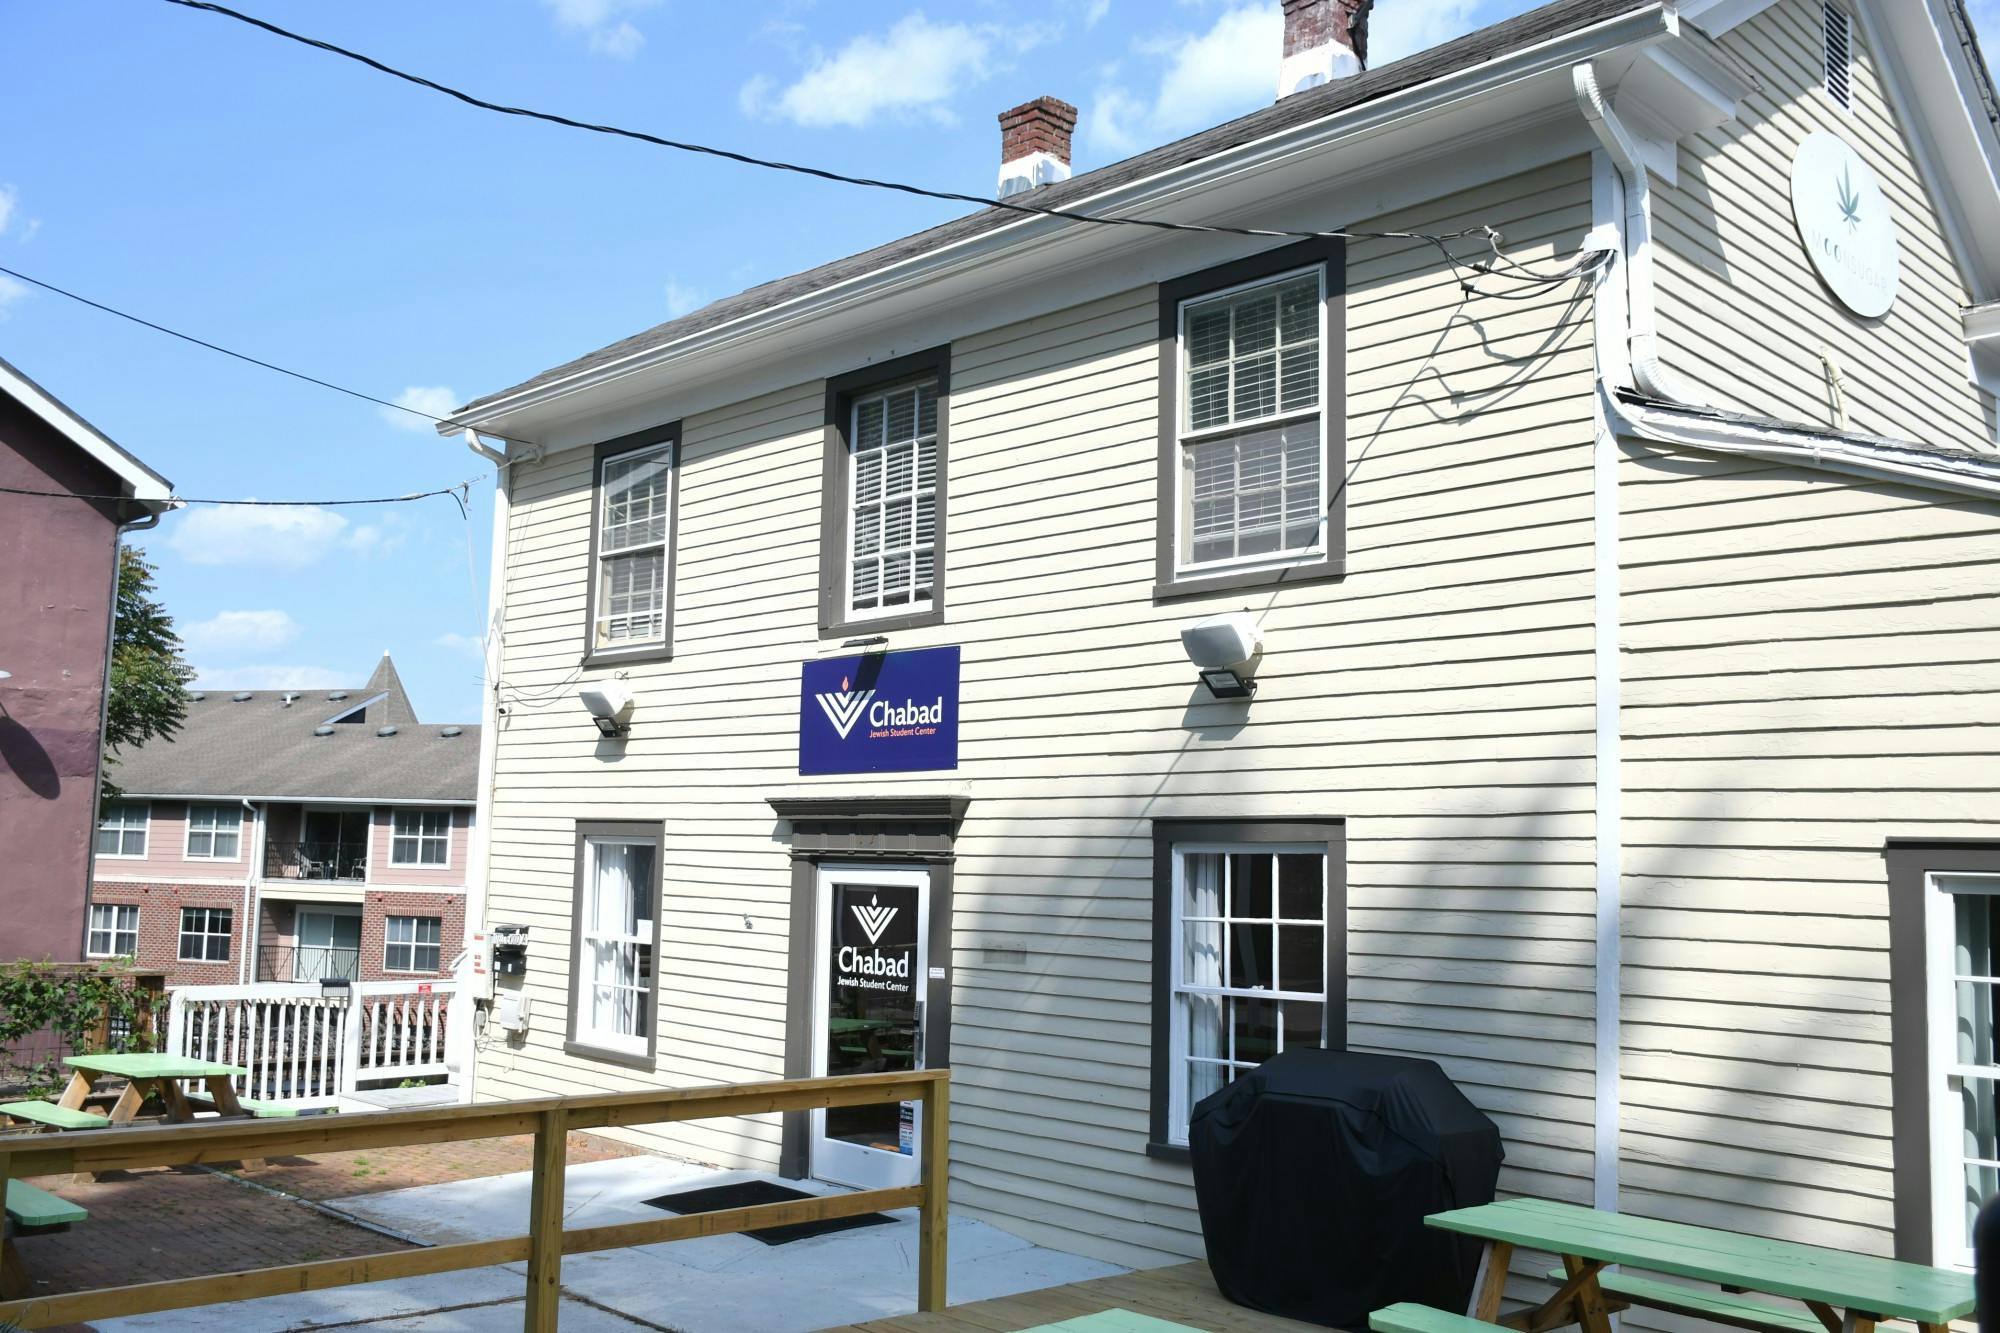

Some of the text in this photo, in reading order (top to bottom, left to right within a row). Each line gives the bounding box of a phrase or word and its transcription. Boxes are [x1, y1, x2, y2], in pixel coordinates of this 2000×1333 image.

[869, 696, 943, 728] Chabad
[869, 726, 937, 738] Jewish Student Center
[838, 946, 909, 978] Chabad
[837, 975, 909, 992] Jewish Student Center
